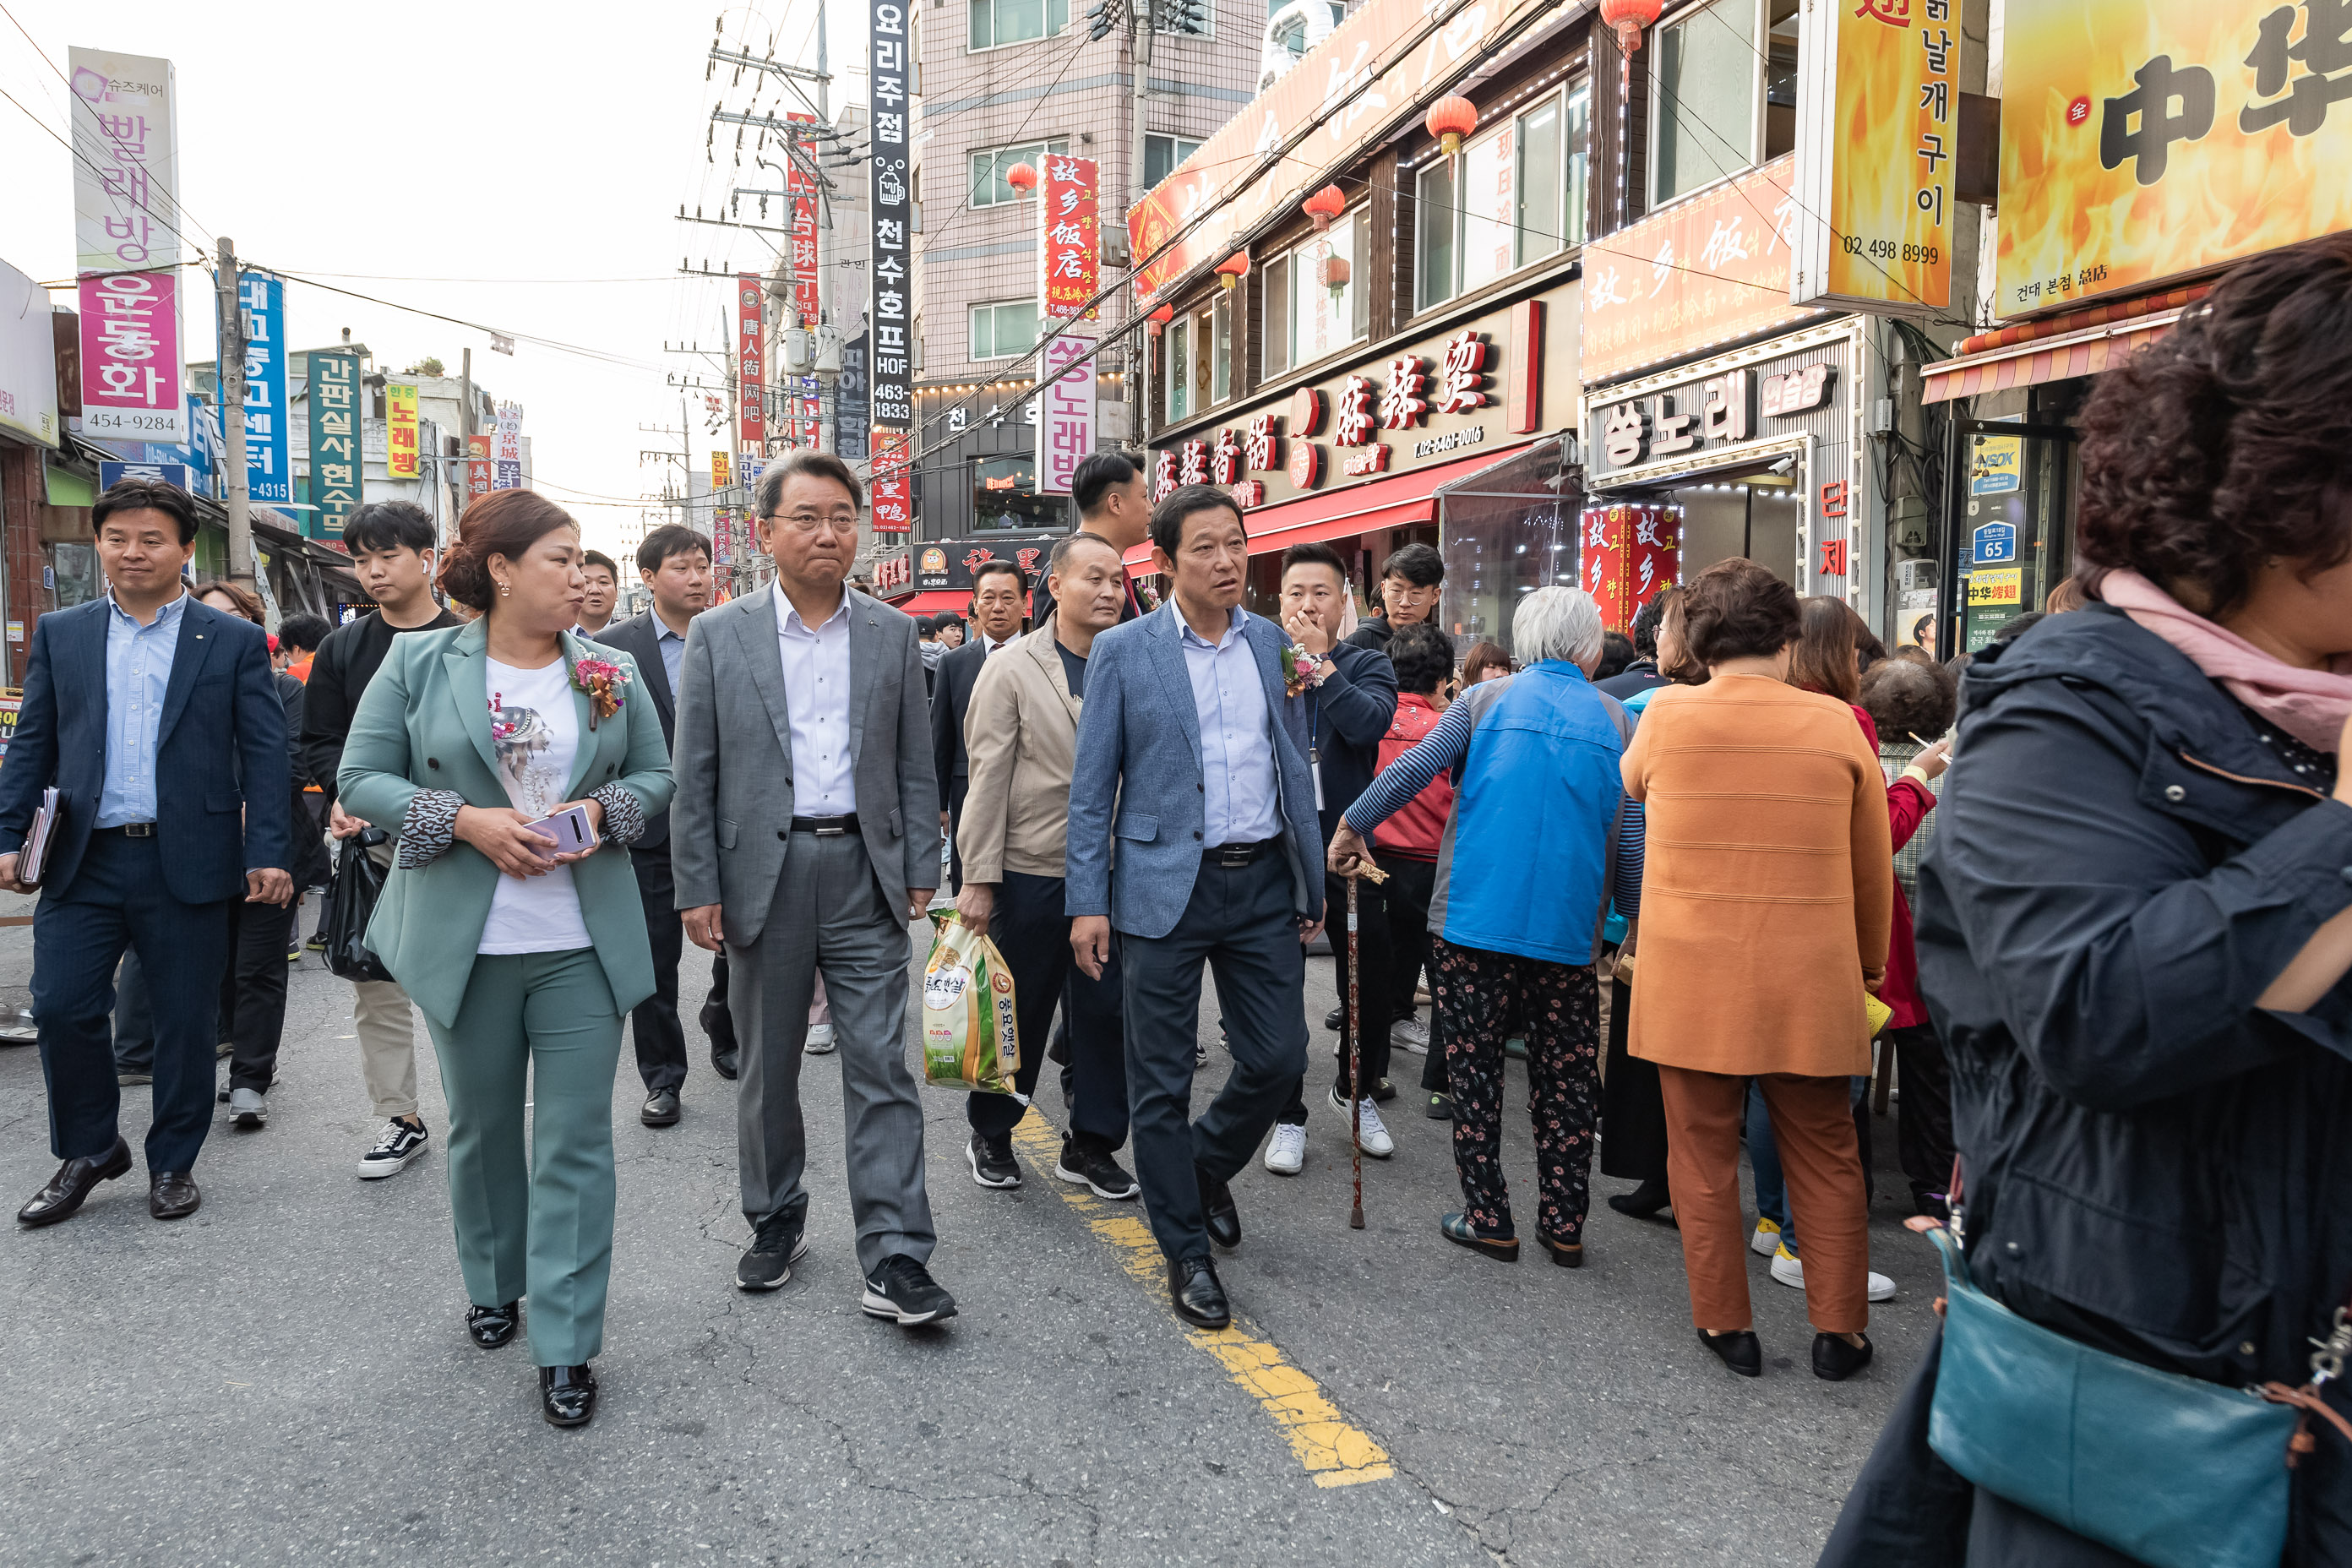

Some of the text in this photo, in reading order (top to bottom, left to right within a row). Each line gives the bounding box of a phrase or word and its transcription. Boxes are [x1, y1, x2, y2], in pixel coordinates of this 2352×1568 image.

[108, 79, 163, 97] 슈즈케어
[875, 3, 903, 144] 요리주점
[99, 113, 155, 263] 빨래방
[1049, 159, 1086, 279] 故乡饭店
[1843, 237, 1939, 265] 02 498 8999
[875, 218, 904, 355] 천수호프
[2017, 281, 2041, 302] 건대
[2046, 273, 2072, 295] 본점
[96, 275, 166, 408] 운동화
[743, 318, 761, 422] 唐人街网吧
[877, 357, 908, 375] HOF
[0, 389, 15, 416] 문점
[390, 386, 415, 398] 한중
[874, 384, 911, 401] 463-
[1332, 329, 1485, 448] 麻辣烫
[1761, 363, 1830, 418] 연습장
[90, 413, 176, 432] 454-9284
[874, 400, 911, 419] 1833
[392, 402, 416, 473] 노래방
[500, 432, 519, 460] 京城
[1413, 425, 1484, 459] T.02-6461-0016
[1153, 413, 1274, 504] 麻辣香锅
[1342, 443, 1386, 476] 마라탕
[1610, 511, 1618, 520] 2F
[1664, 511, 1674, 520] 2F
[1819, 479, 1848, 576] 단체
[1985, 542, 2003, 558] 65
[1588, 514, 1609, 622] 故乡
[1968, 585, 2017, 601] 中华烤翅
